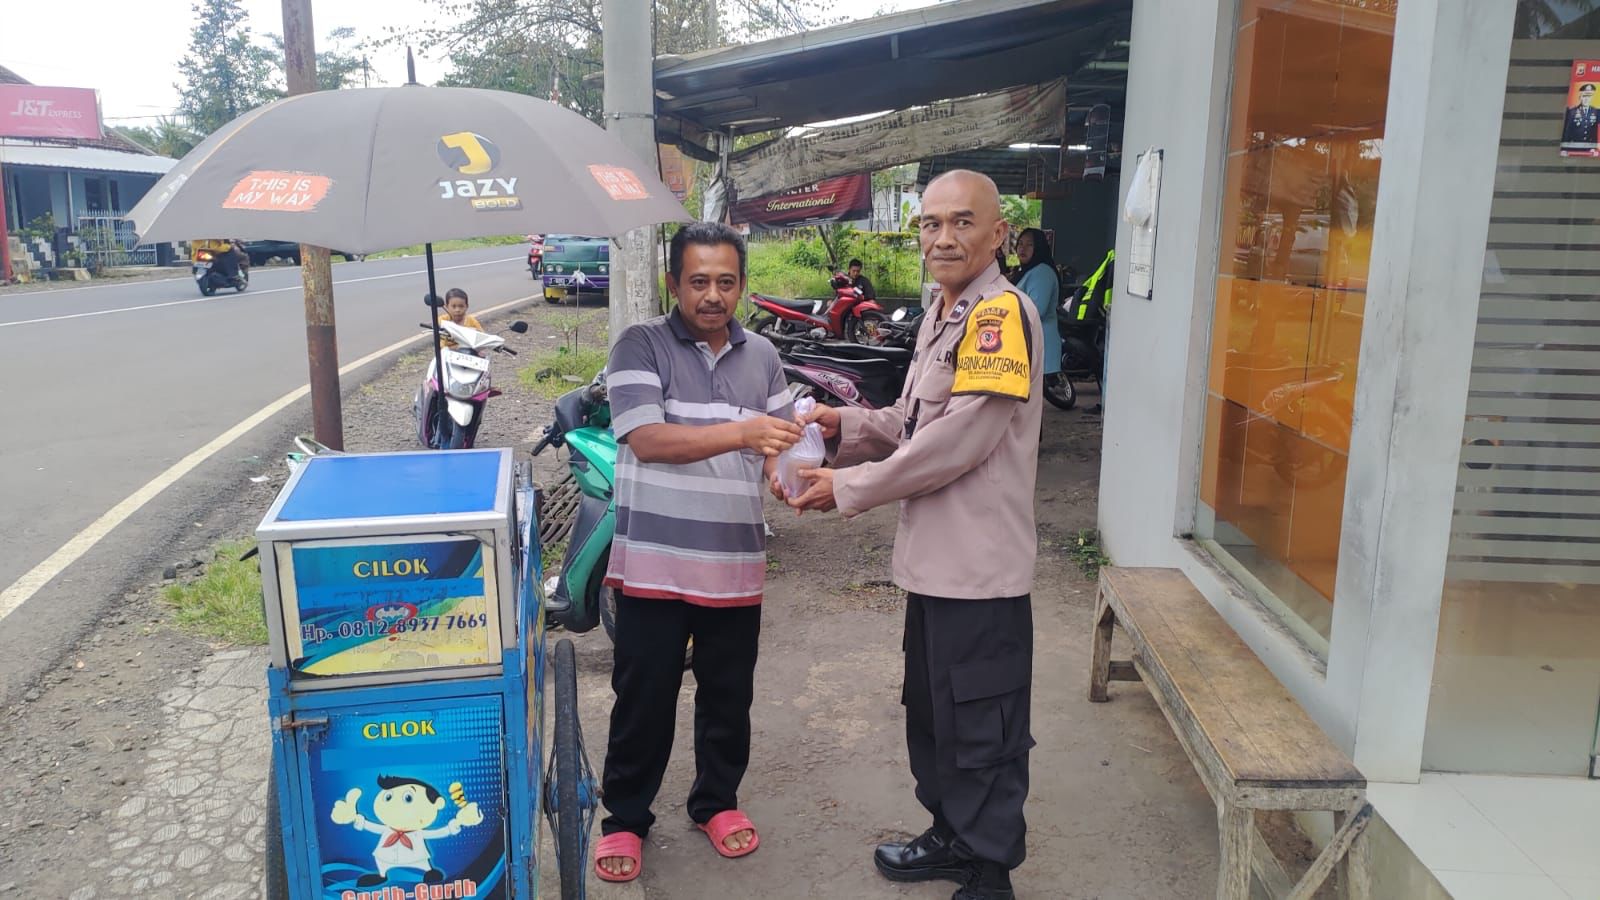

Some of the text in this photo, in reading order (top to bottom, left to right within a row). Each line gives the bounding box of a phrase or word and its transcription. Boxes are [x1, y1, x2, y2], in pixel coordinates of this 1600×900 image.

[10, 99, 82, 119] J&T EXPRESS
[249, 177, 312, 192] THIS IS
[233, 191, 312, 206] MY WAY
[474, 198, 518, 209] BOLD
[766, 193, 836, 212] International
[352, 557, 430, 579] CILOK
[301, 612, 487, 644] Hp. 0812 8937 7669
[361, 719, 436, 740] CILOK
